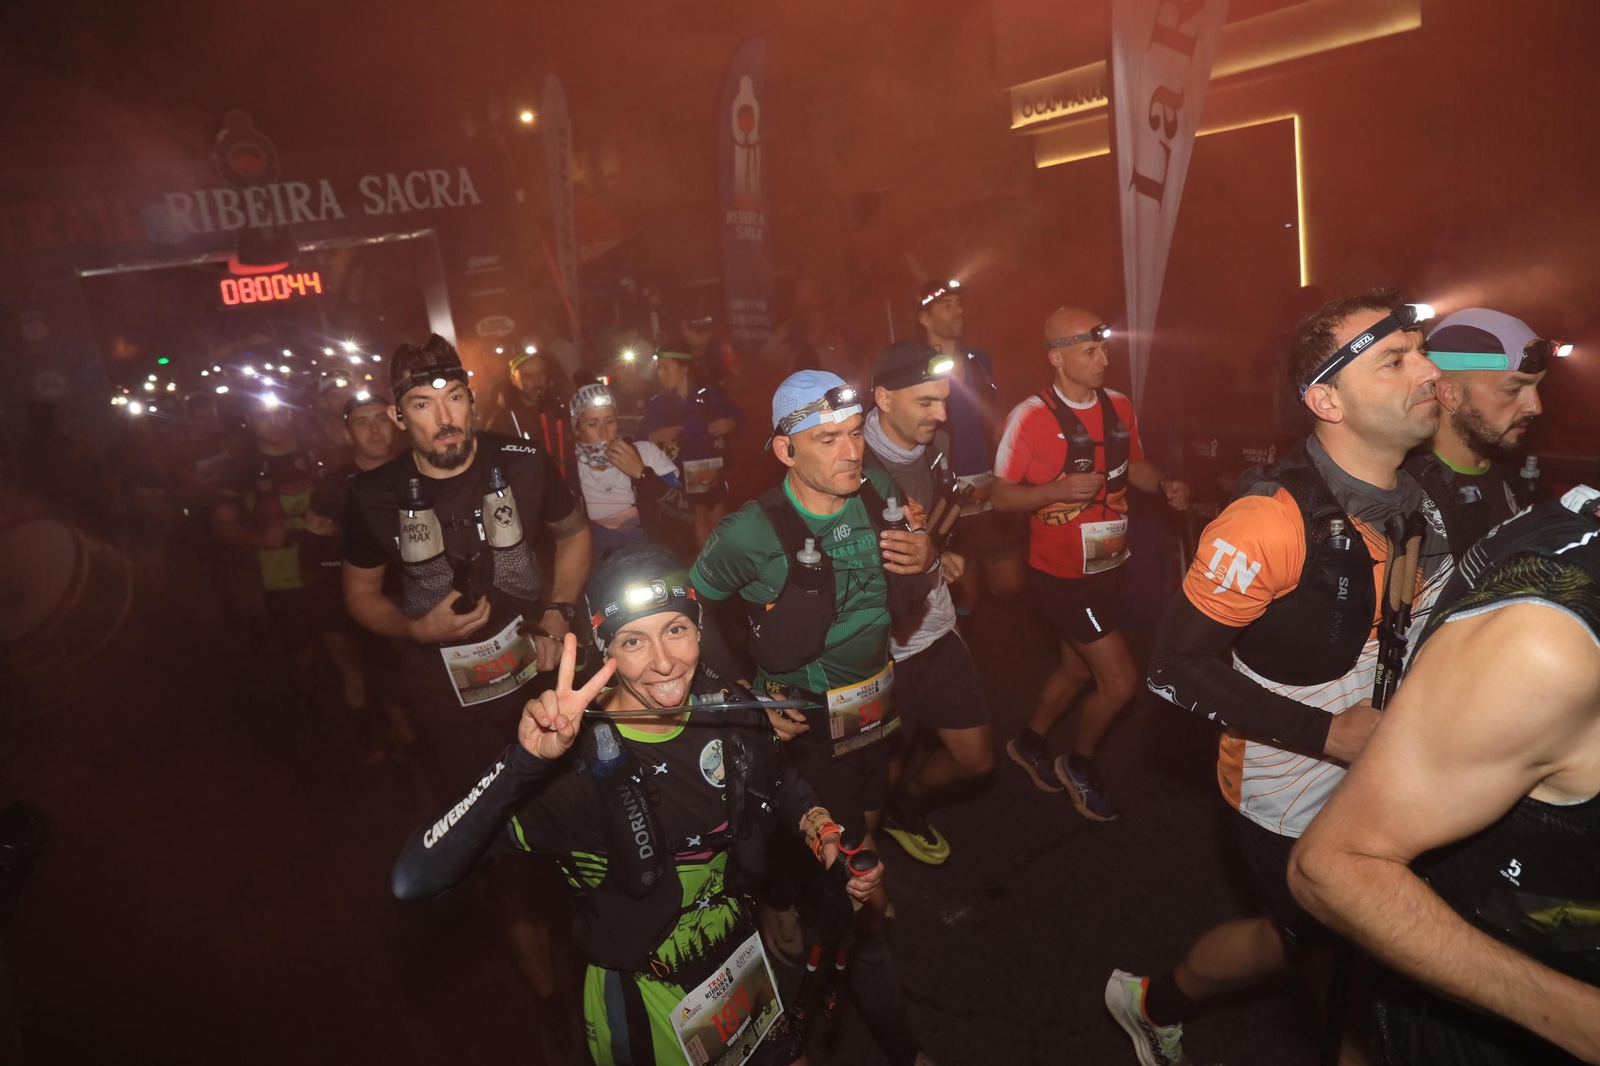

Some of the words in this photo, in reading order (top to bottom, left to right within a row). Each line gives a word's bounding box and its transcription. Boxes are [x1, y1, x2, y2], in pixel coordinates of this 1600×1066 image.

[162, 179, 348, 234] RIBEIRA
[358, 166, 483, 217] SACRA
[1351, 333, 1374, 353] PETZL
[501, 444, 537, 454] JOLUVI
[408, 532, 431, 543] MAX
[605, 603, 619, 617] PETZL
[1085, 607, 1102, 632] SALOMON
[472, 650, 517, 683] 234
[1507, 858, 1522, 877] 5
[704, 977, 727, 1000] RIBEIRA
[707, 972, 726, 990] TRAIL
[711, 983, 730, 1002] SACRA
[710, 984, 752, 1044] 184
